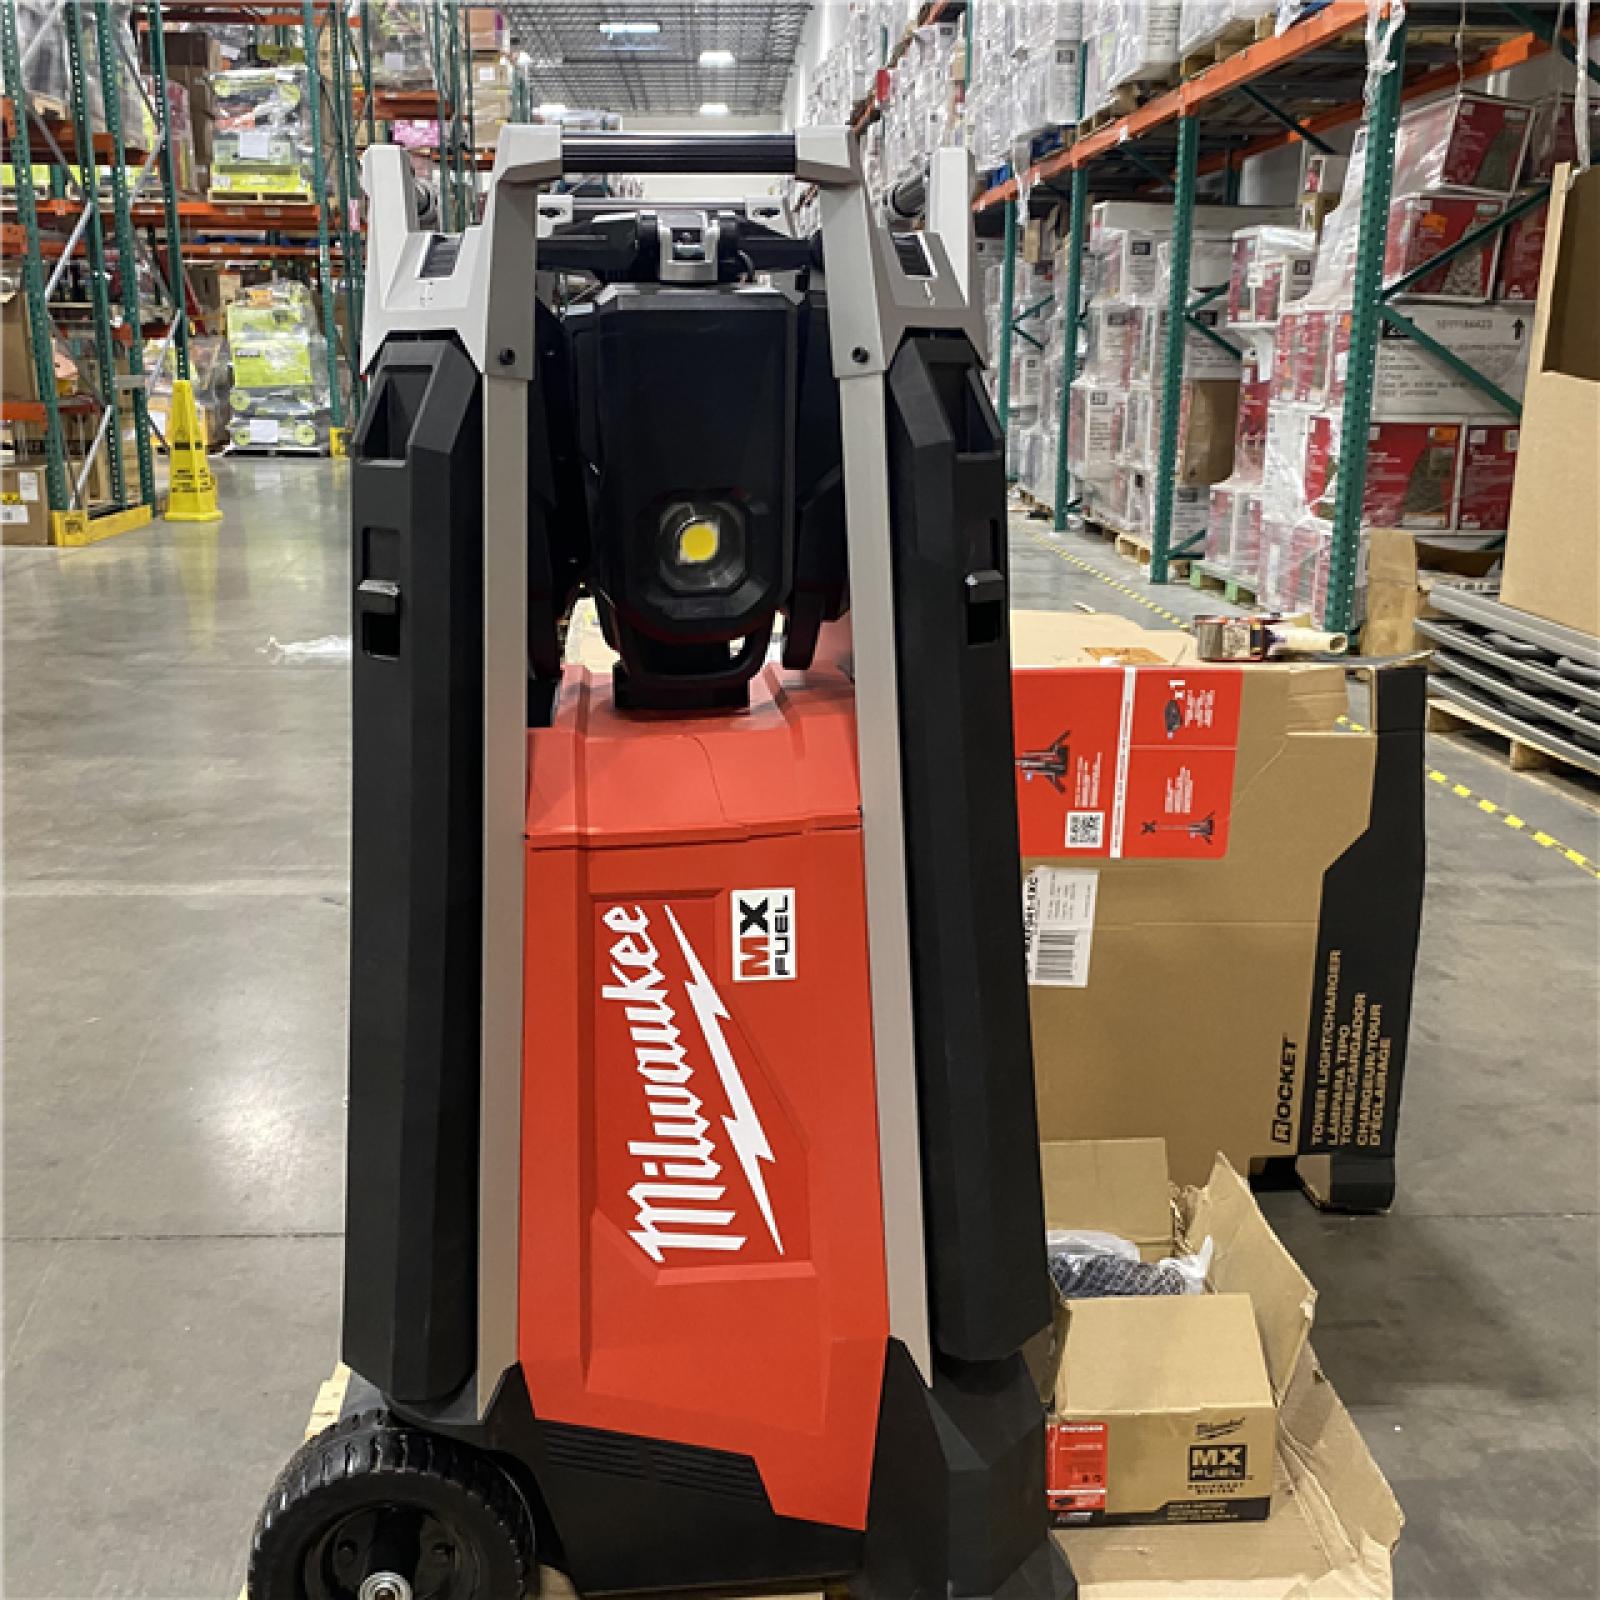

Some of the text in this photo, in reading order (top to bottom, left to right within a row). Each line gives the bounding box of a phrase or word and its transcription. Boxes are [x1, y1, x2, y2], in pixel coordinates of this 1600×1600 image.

[740, 897, 769, 976] MX
[775, 895, 789, 976] FUEL
[602, 904, 747, 1262] Milwaukee
[1272, 1032, 1297, 1145] ROCKET
[1312, 950, 1341, 1146] TOWER LIGHT/CHARGER
[1336, 1024, 1350, 1063] TIPO
[1340, 992, 1366, 1146] TORRE/CARGADOR
[1357, 1004, 1381, 1146] CHARGEUR/TOUR
[1191, 1448, 1241, 1465] MX
[1191, 1467, 1241, 1479] FUEL
